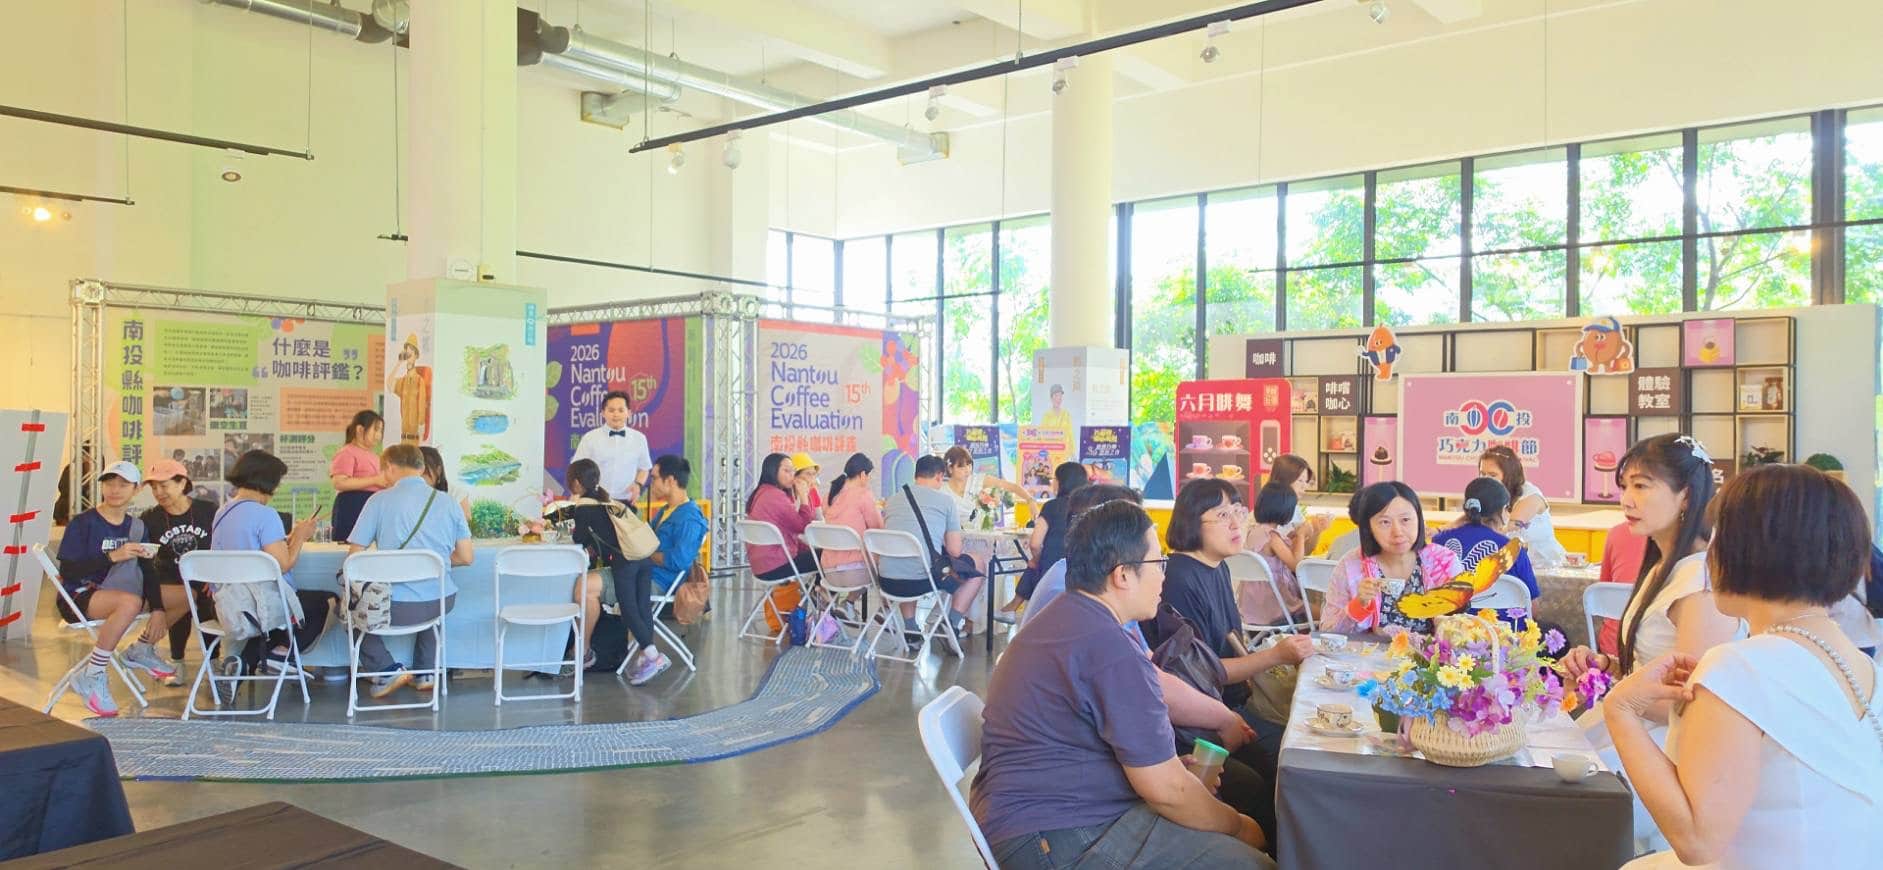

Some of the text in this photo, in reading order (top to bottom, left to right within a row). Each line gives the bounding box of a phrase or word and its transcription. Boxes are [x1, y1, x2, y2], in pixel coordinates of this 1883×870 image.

[272, 337, 331, 358] 什麼是
[571, 344, 600, 362] 2026
[771, 342, 808, 360] 2026
[1252, 352, 1277, 366] 咖啡
[571, 363, 626, 384] Nantou
[771, 361, 838, 385] Nantou
[631, 376, 657, 401] 15th
[770, 385, 831, 408] Coffee
[845, 381, 872, 405] 15th
[1325, 397, 1351, 410] 咖心
[1638, 394, 1671, 409] 教室
[771, 407, 863, 431] Evaluation
[1446, 412, 1459, 425] 南
